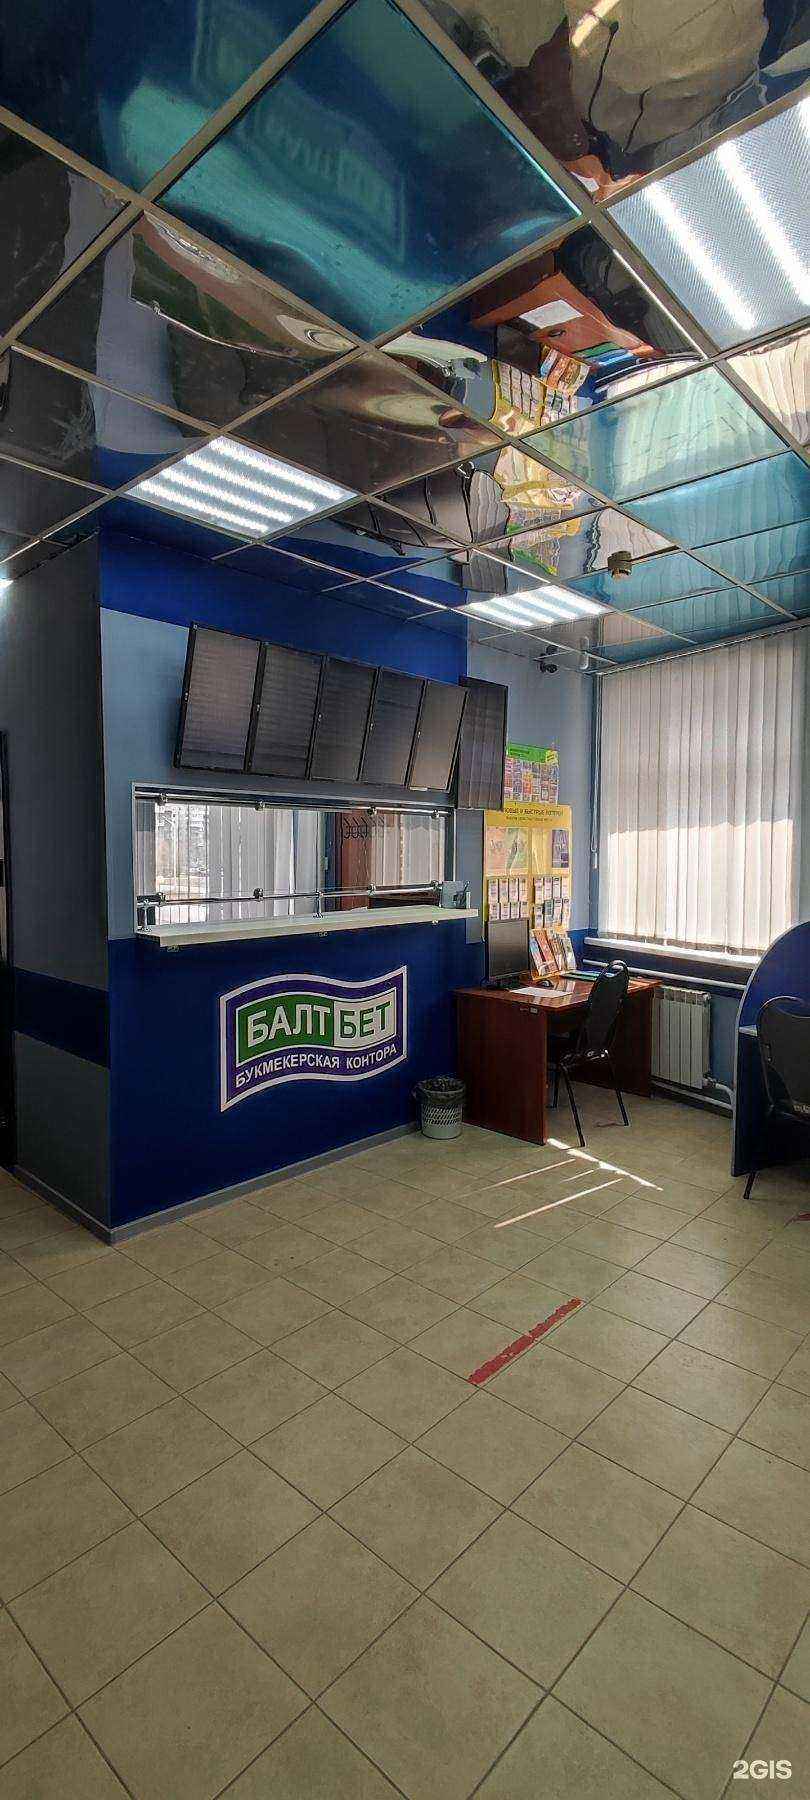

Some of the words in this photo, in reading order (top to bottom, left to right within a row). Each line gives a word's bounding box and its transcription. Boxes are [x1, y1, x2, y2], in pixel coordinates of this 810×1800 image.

[247, 1003, 331, 1048] БАЛТ
[340, 1001, 392, 1039] БЕТ
[235, 1052, 340, 1088] БУКМЕКЕРСКАЯ
[346, 1043, 397, 1069] КОНТОРА
